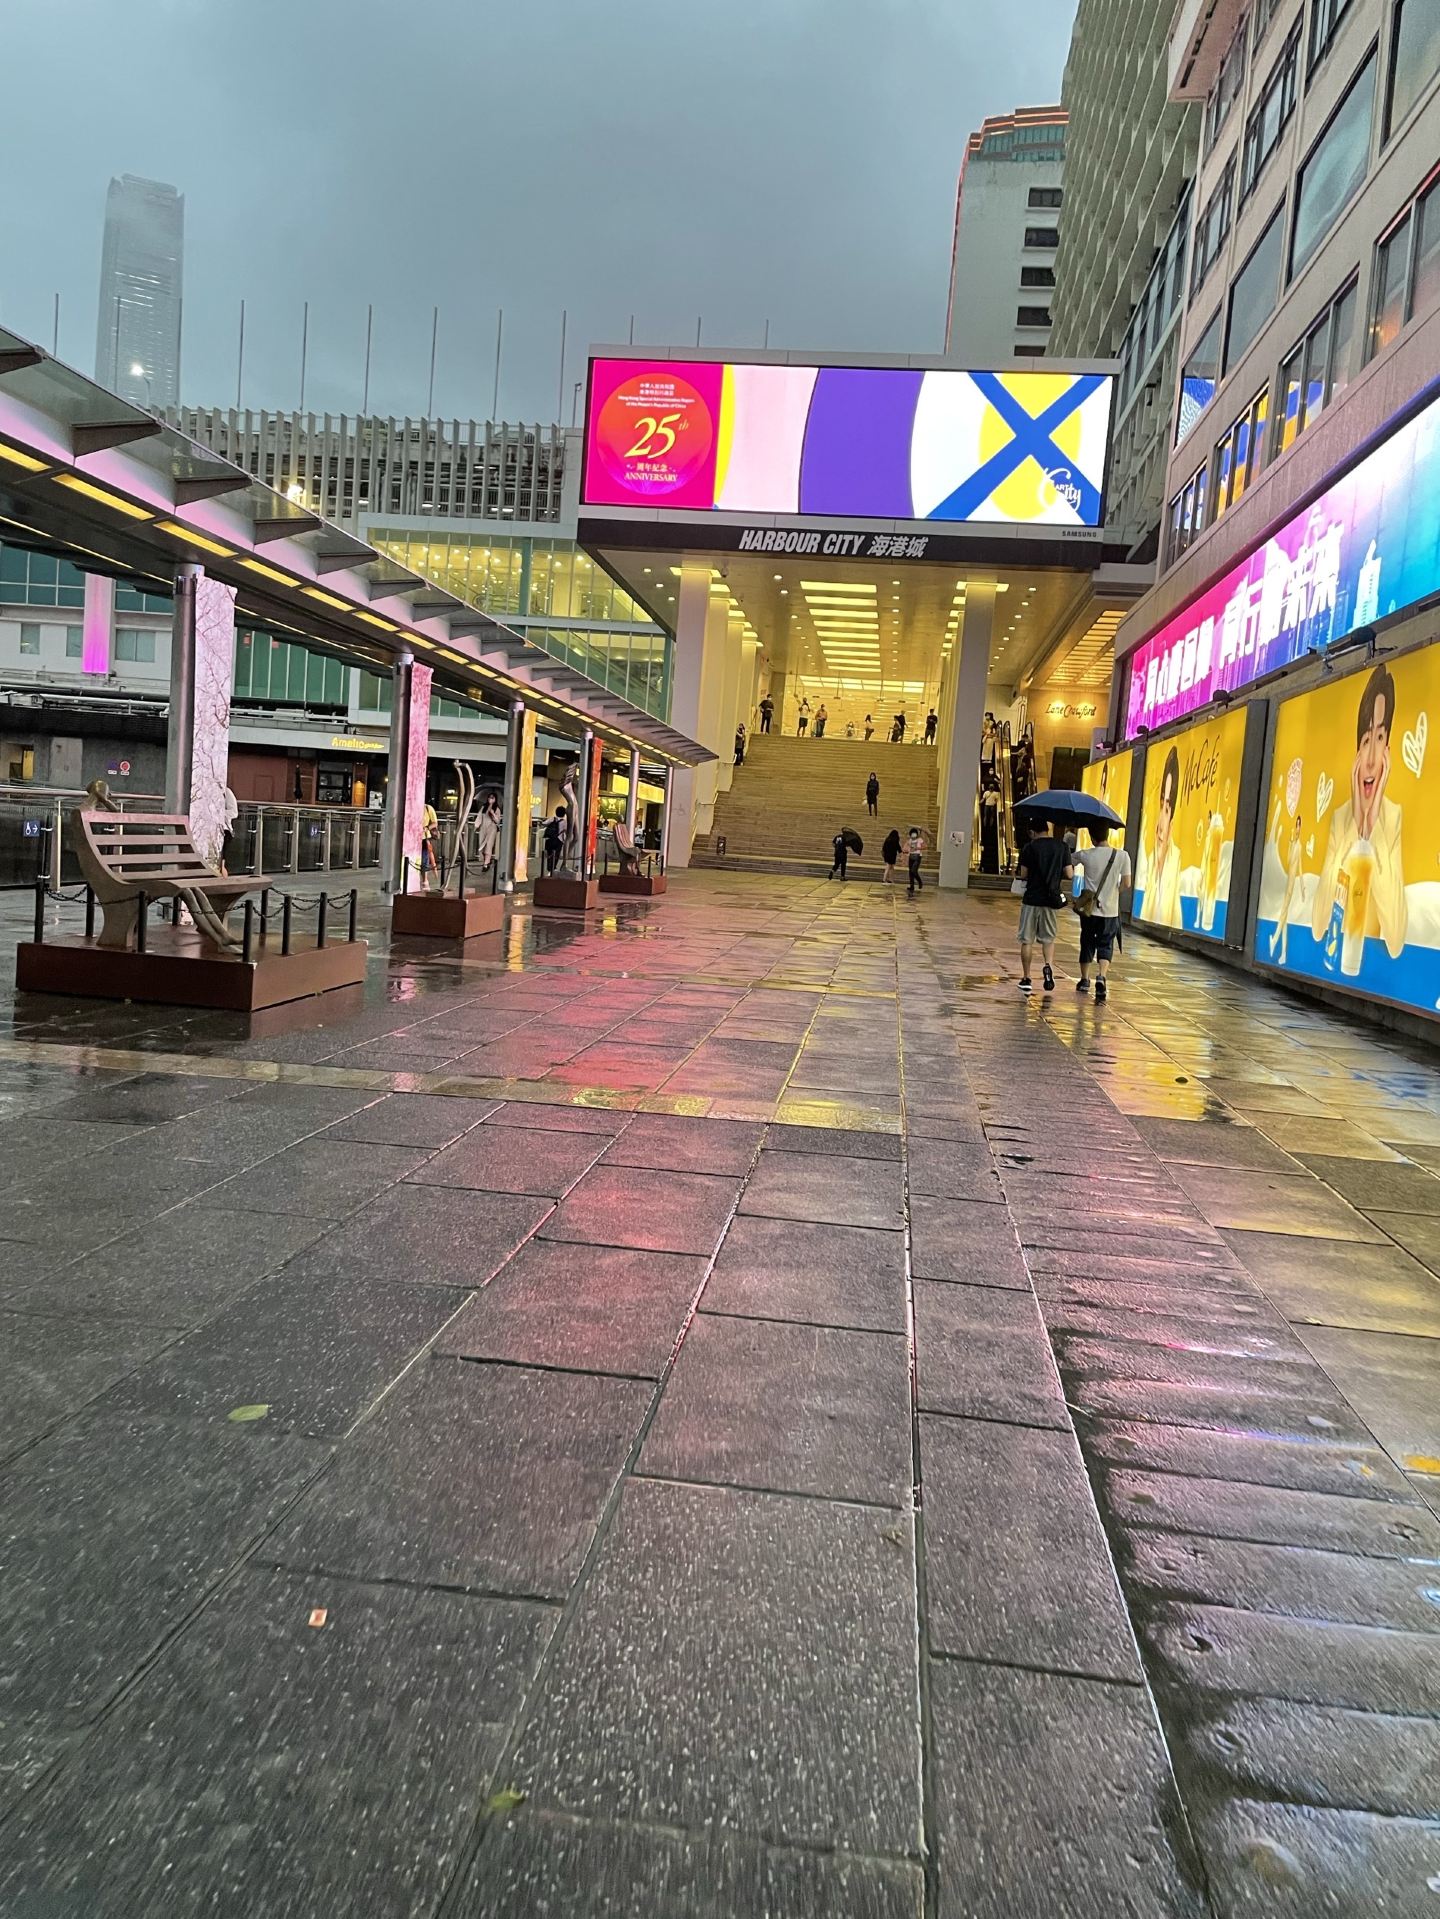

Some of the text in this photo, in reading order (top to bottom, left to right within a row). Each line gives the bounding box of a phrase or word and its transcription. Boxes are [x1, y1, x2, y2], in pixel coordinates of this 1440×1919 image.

[624, 472, 678, 482] ANNIVERSARY
[1062, 530, 1097, 538] SAMSUNG
[739, 530, 929, 558] HARBOUR CITY 海港城
